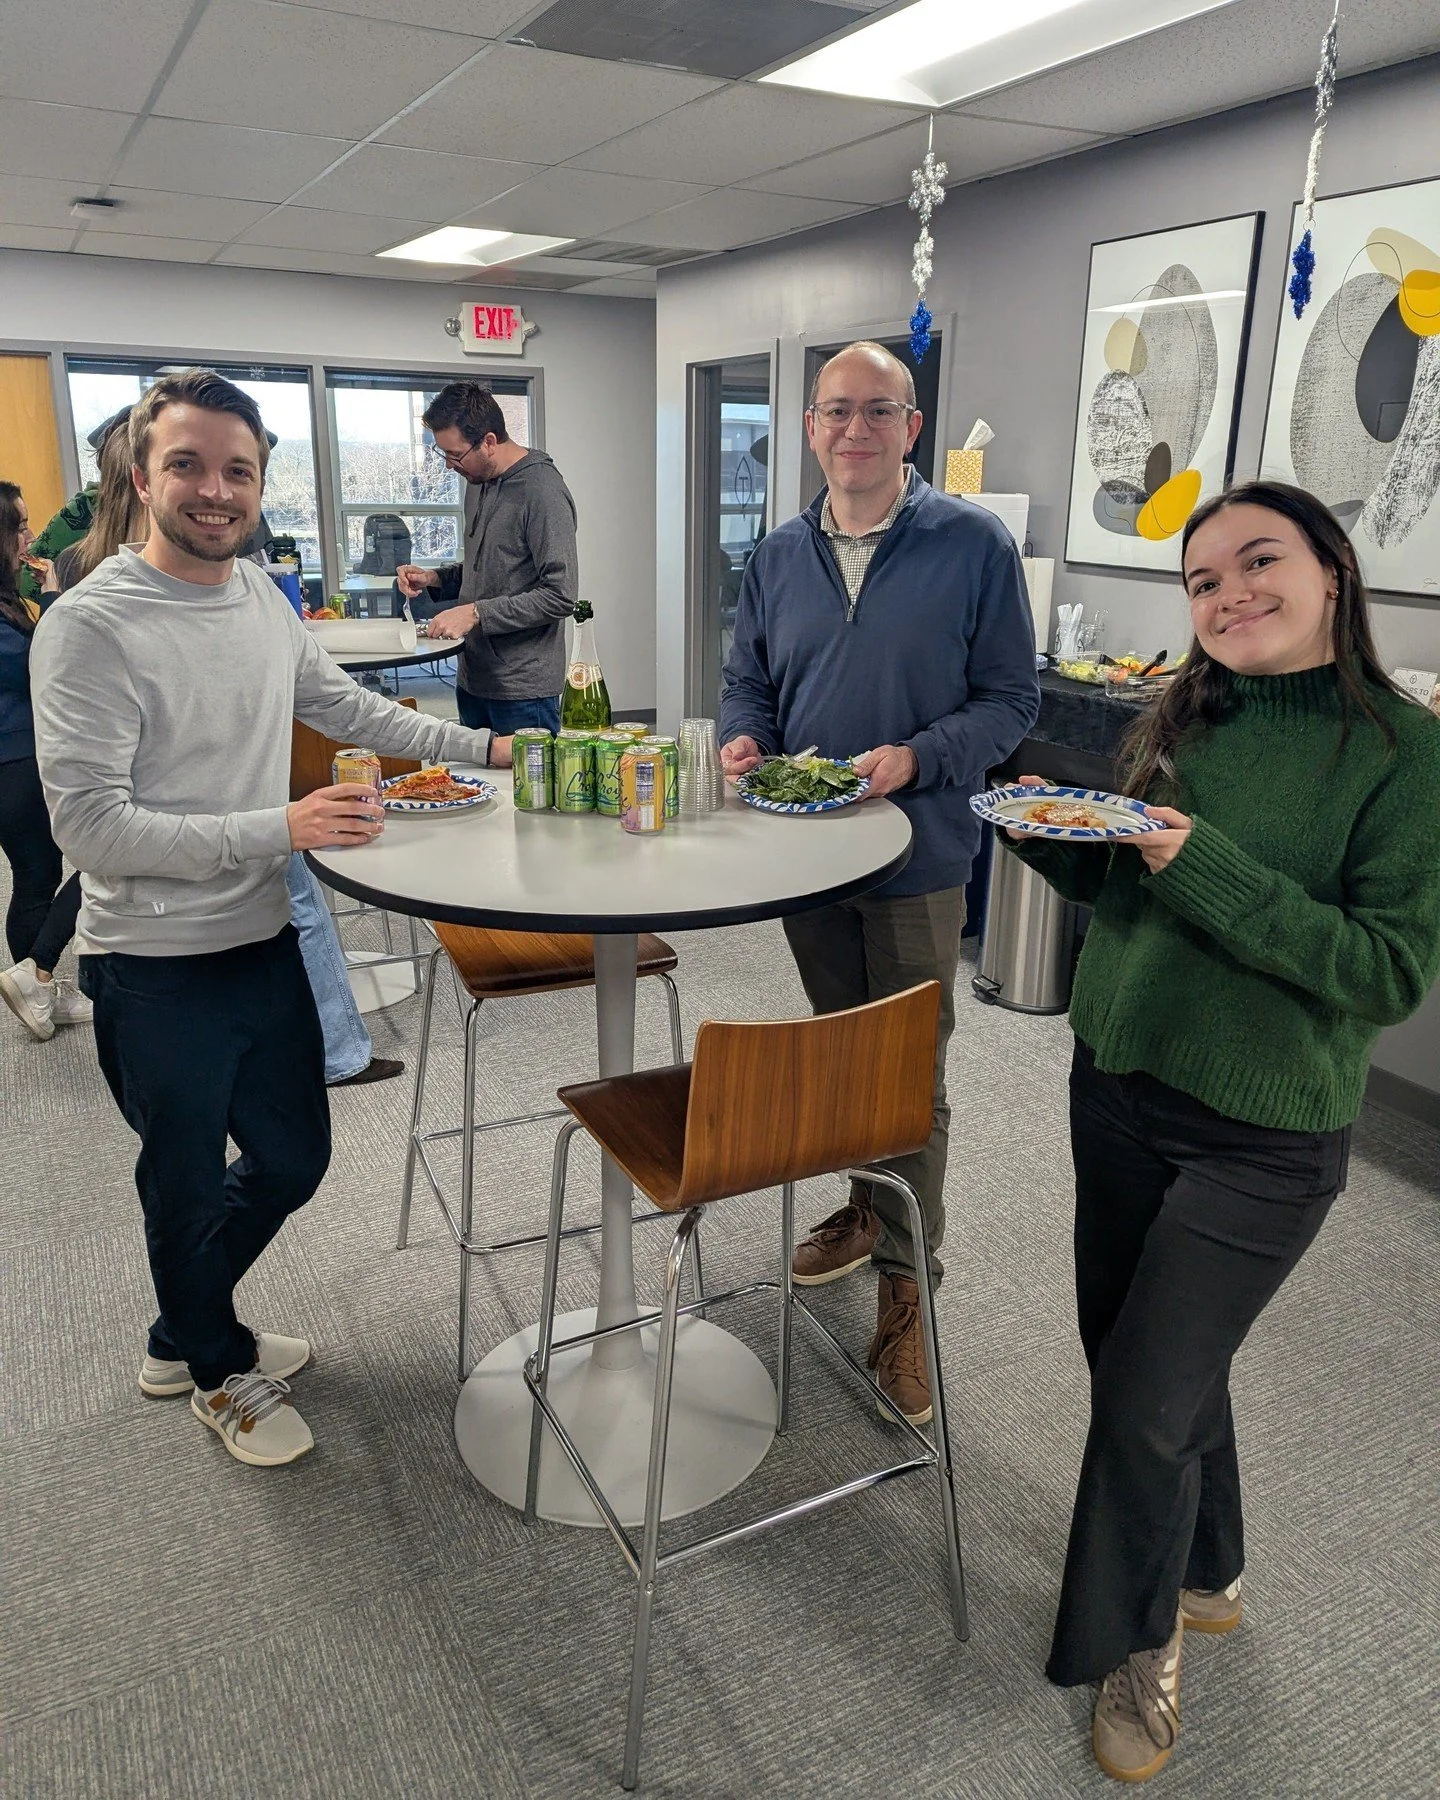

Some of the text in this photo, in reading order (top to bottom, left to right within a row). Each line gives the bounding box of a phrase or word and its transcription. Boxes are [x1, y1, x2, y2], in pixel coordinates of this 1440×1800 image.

[474, 306, 514, 338] EXIT
[1402, 685, 1430, 696] ERS TO
